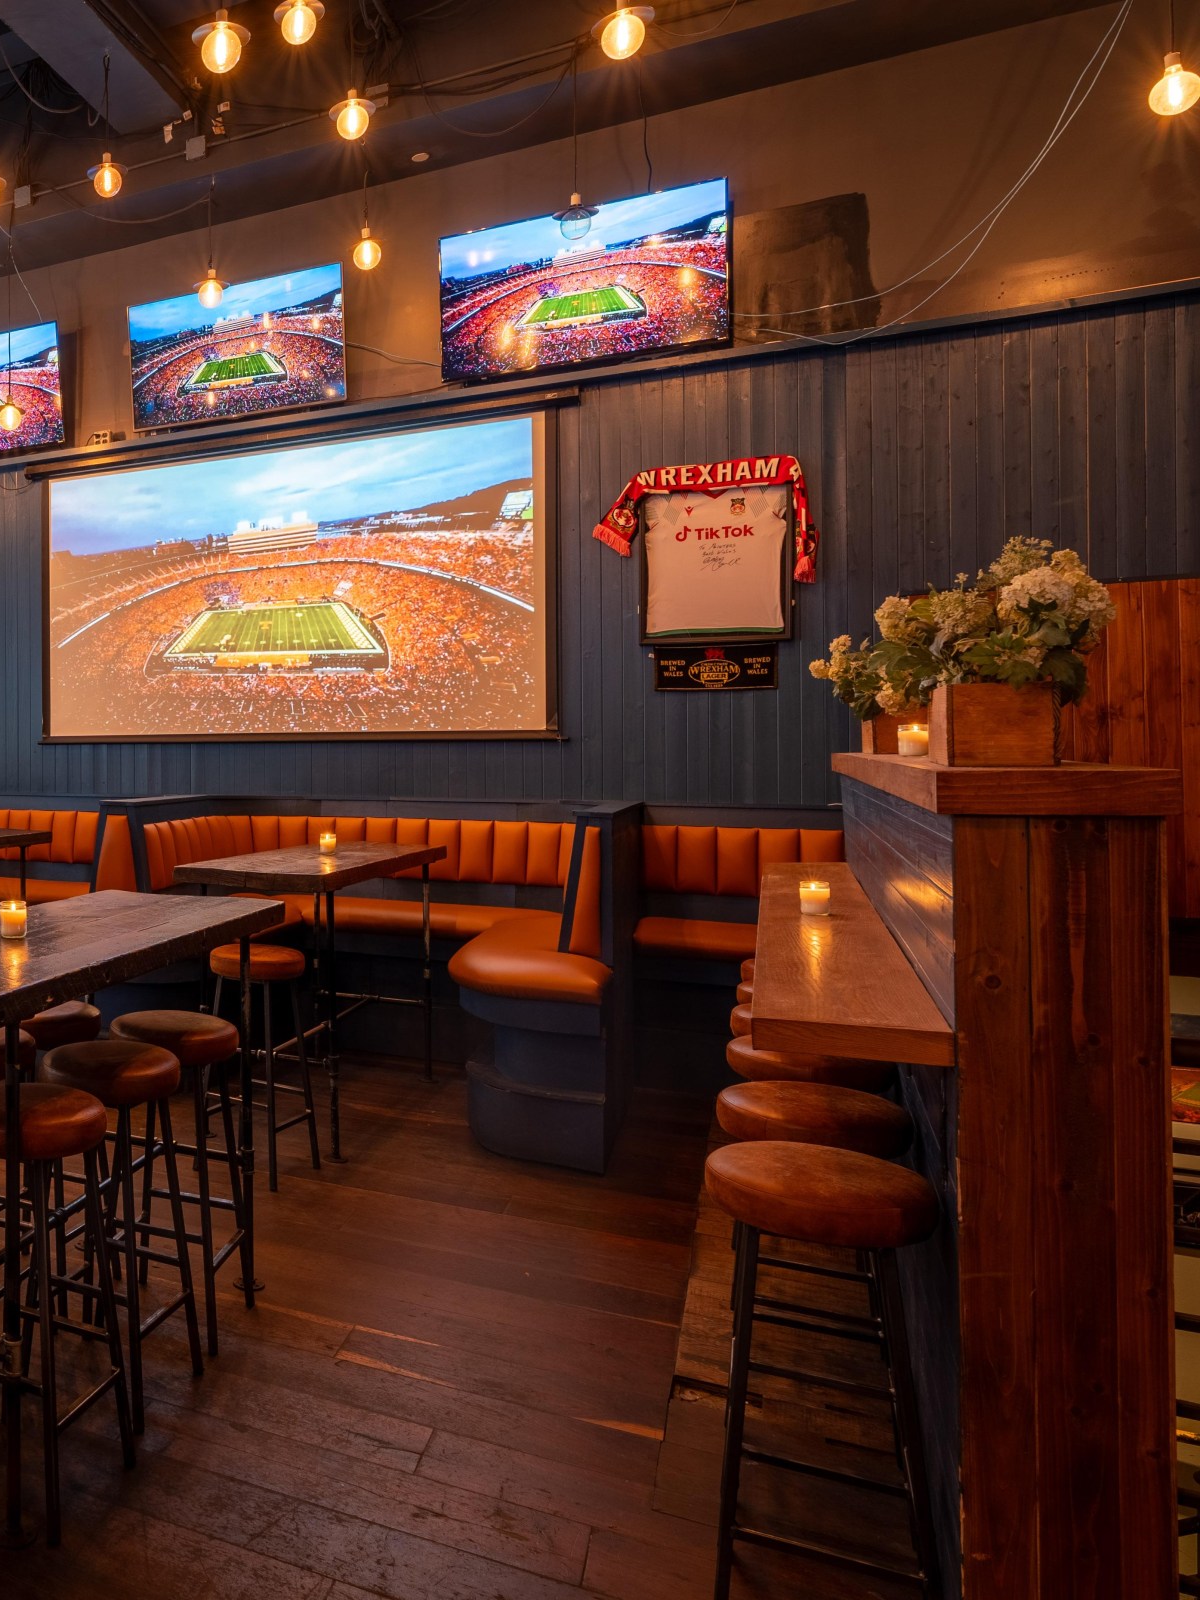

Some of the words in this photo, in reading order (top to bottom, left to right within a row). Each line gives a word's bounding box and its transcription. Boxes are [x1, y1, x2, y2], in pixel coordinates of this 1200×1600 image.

[637, 457, 780, 487] WREXHAM
[744, 656, 771, 664] BREWED
[689, 665, 739, 675] WREXHAM
